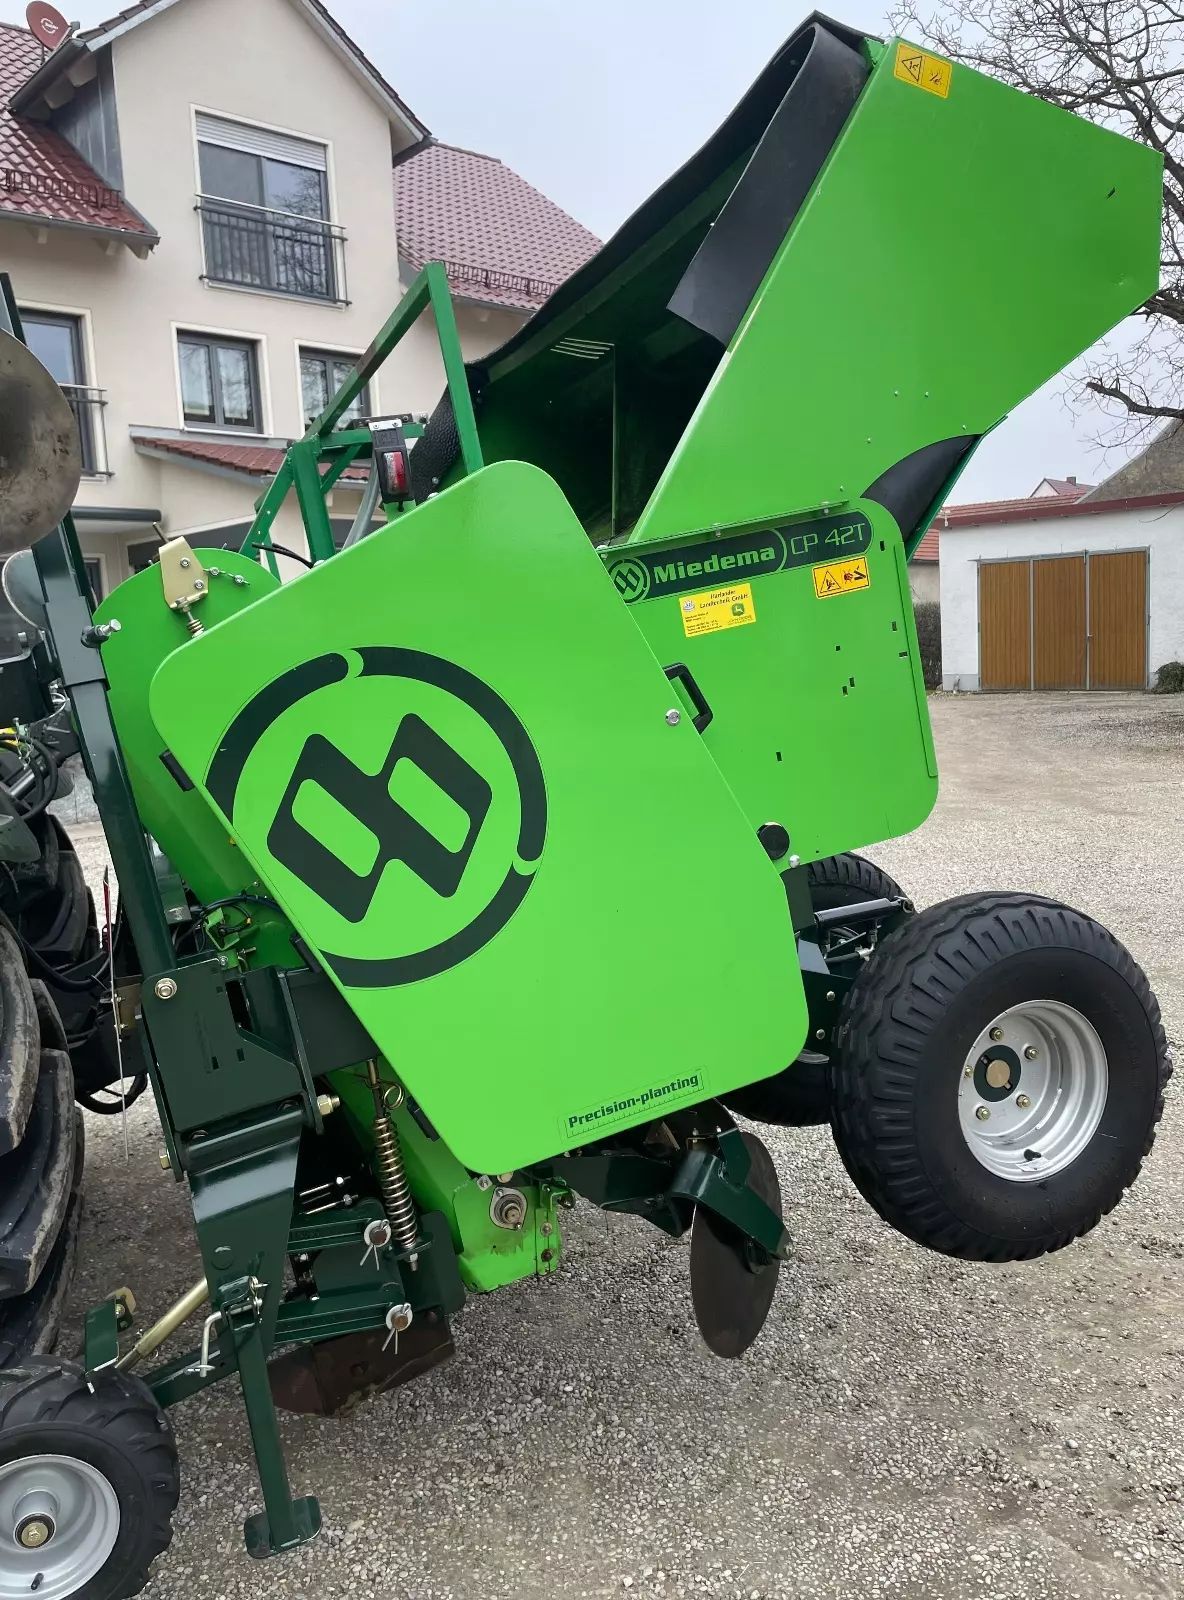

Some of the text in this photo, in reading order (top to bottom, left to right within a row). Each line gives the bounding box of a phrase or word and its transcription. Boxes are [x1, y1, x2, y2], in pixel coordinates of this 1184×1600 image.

[790, 523, 866, 555] CP 42T
[653, 546, 776, 584] Miedema
[568, 1075, 699, 1128] Precision-planting
